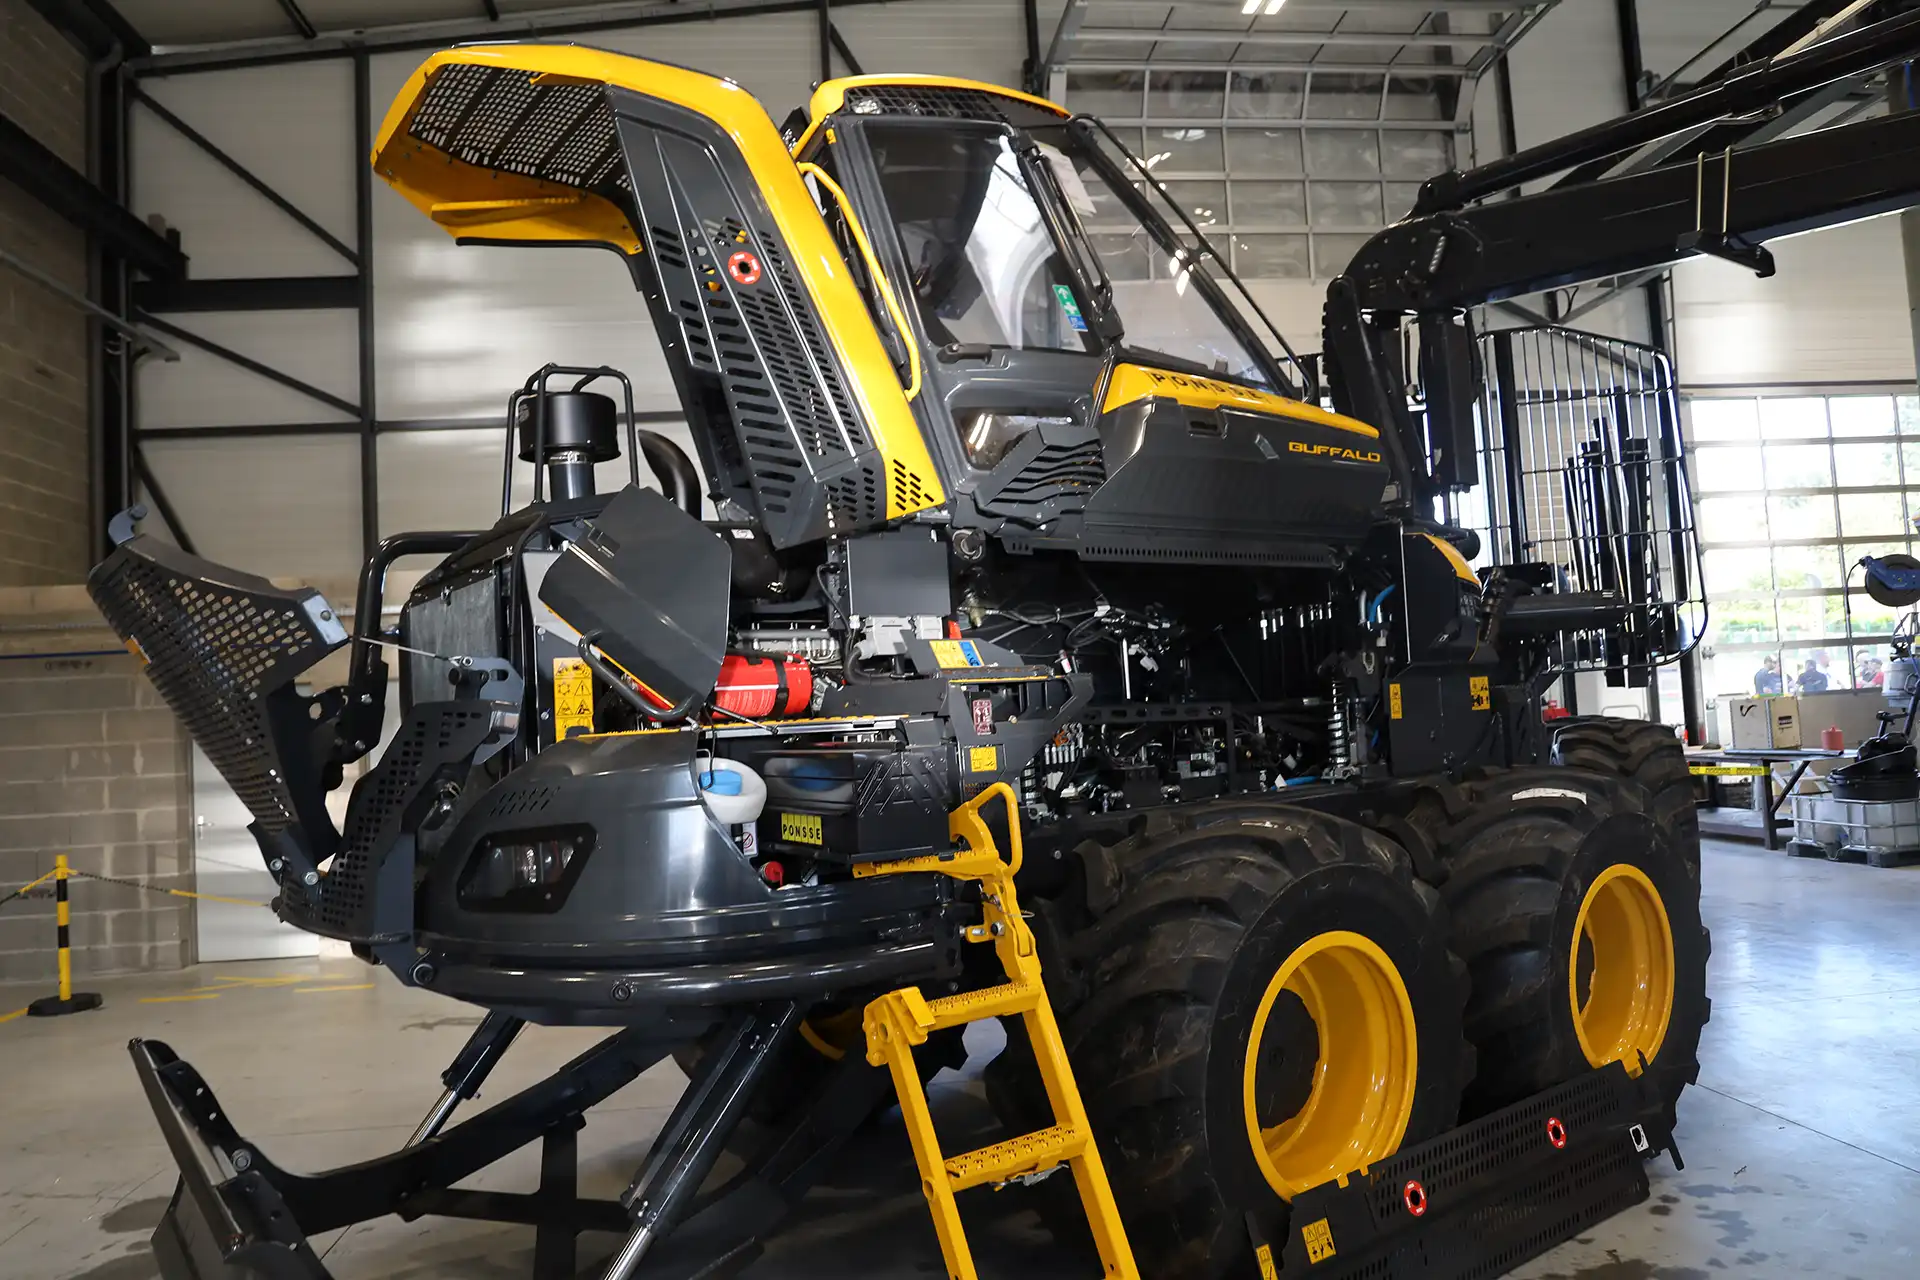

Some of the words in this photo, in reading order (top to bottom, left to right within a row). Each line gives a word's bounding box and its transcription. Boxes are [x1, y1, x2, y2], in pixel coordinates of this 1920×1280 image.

[1152, 372, 1264, 399] PONSSE
[1288, 441, 1381, 463] BUFFALO
[782, 823, 821, 840] PONSSE
